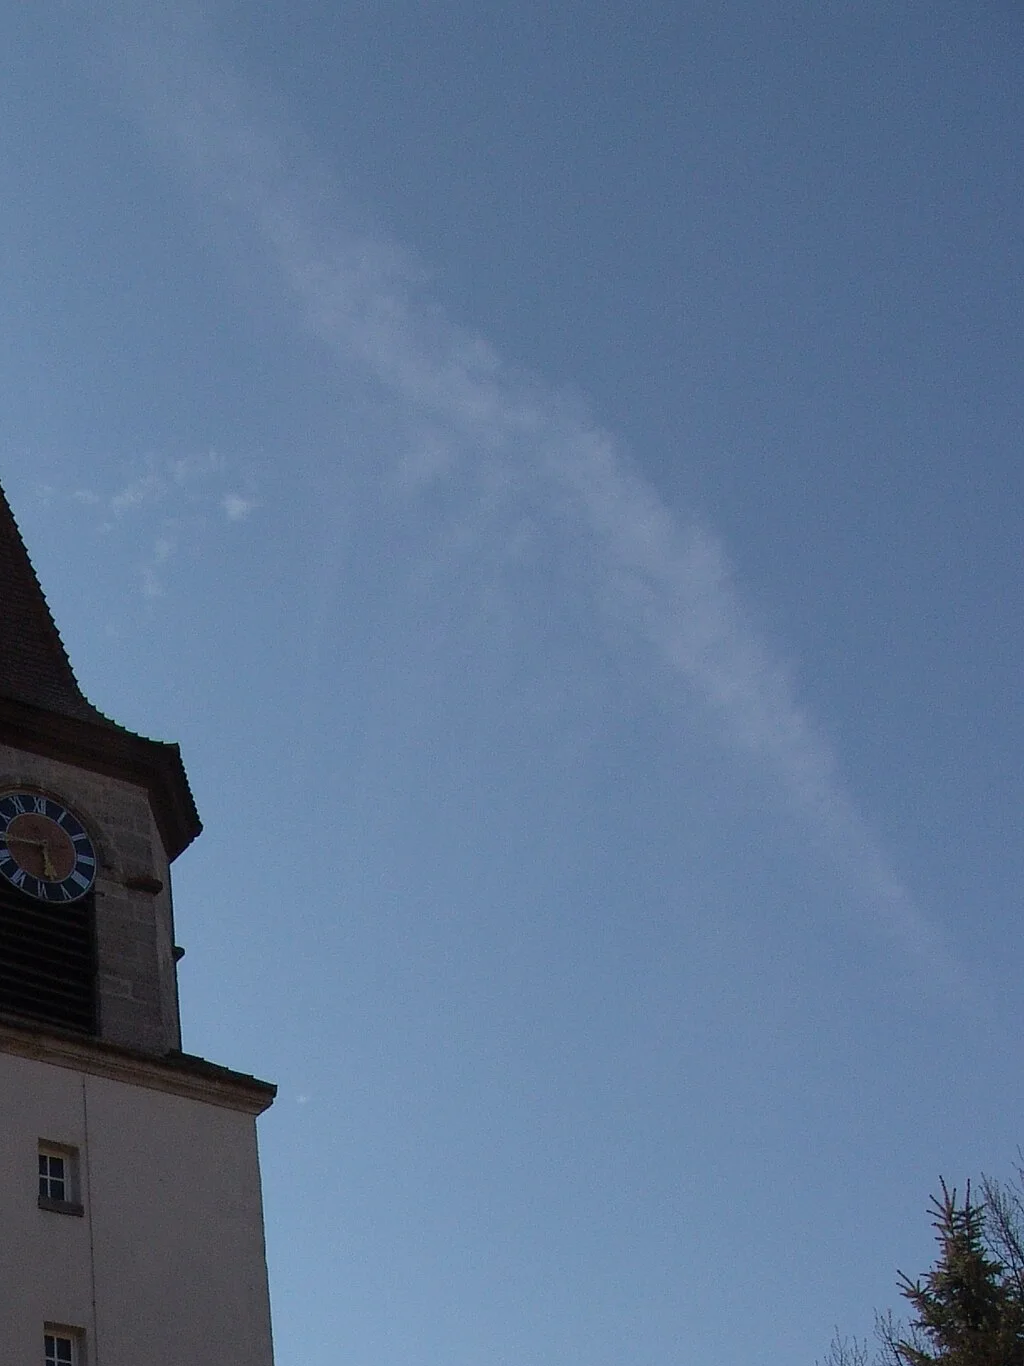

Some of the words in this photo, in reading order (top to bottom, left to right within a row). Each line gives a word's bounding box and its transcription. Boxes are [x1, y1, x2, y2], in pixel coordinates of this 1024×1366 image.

[8, 796, 26, 813] XI
[33, 796, 47, 815] XII
[57, 811, 67, 824] I
[71, 833, 86, 842] II
[60, 883, 72, 900] V
